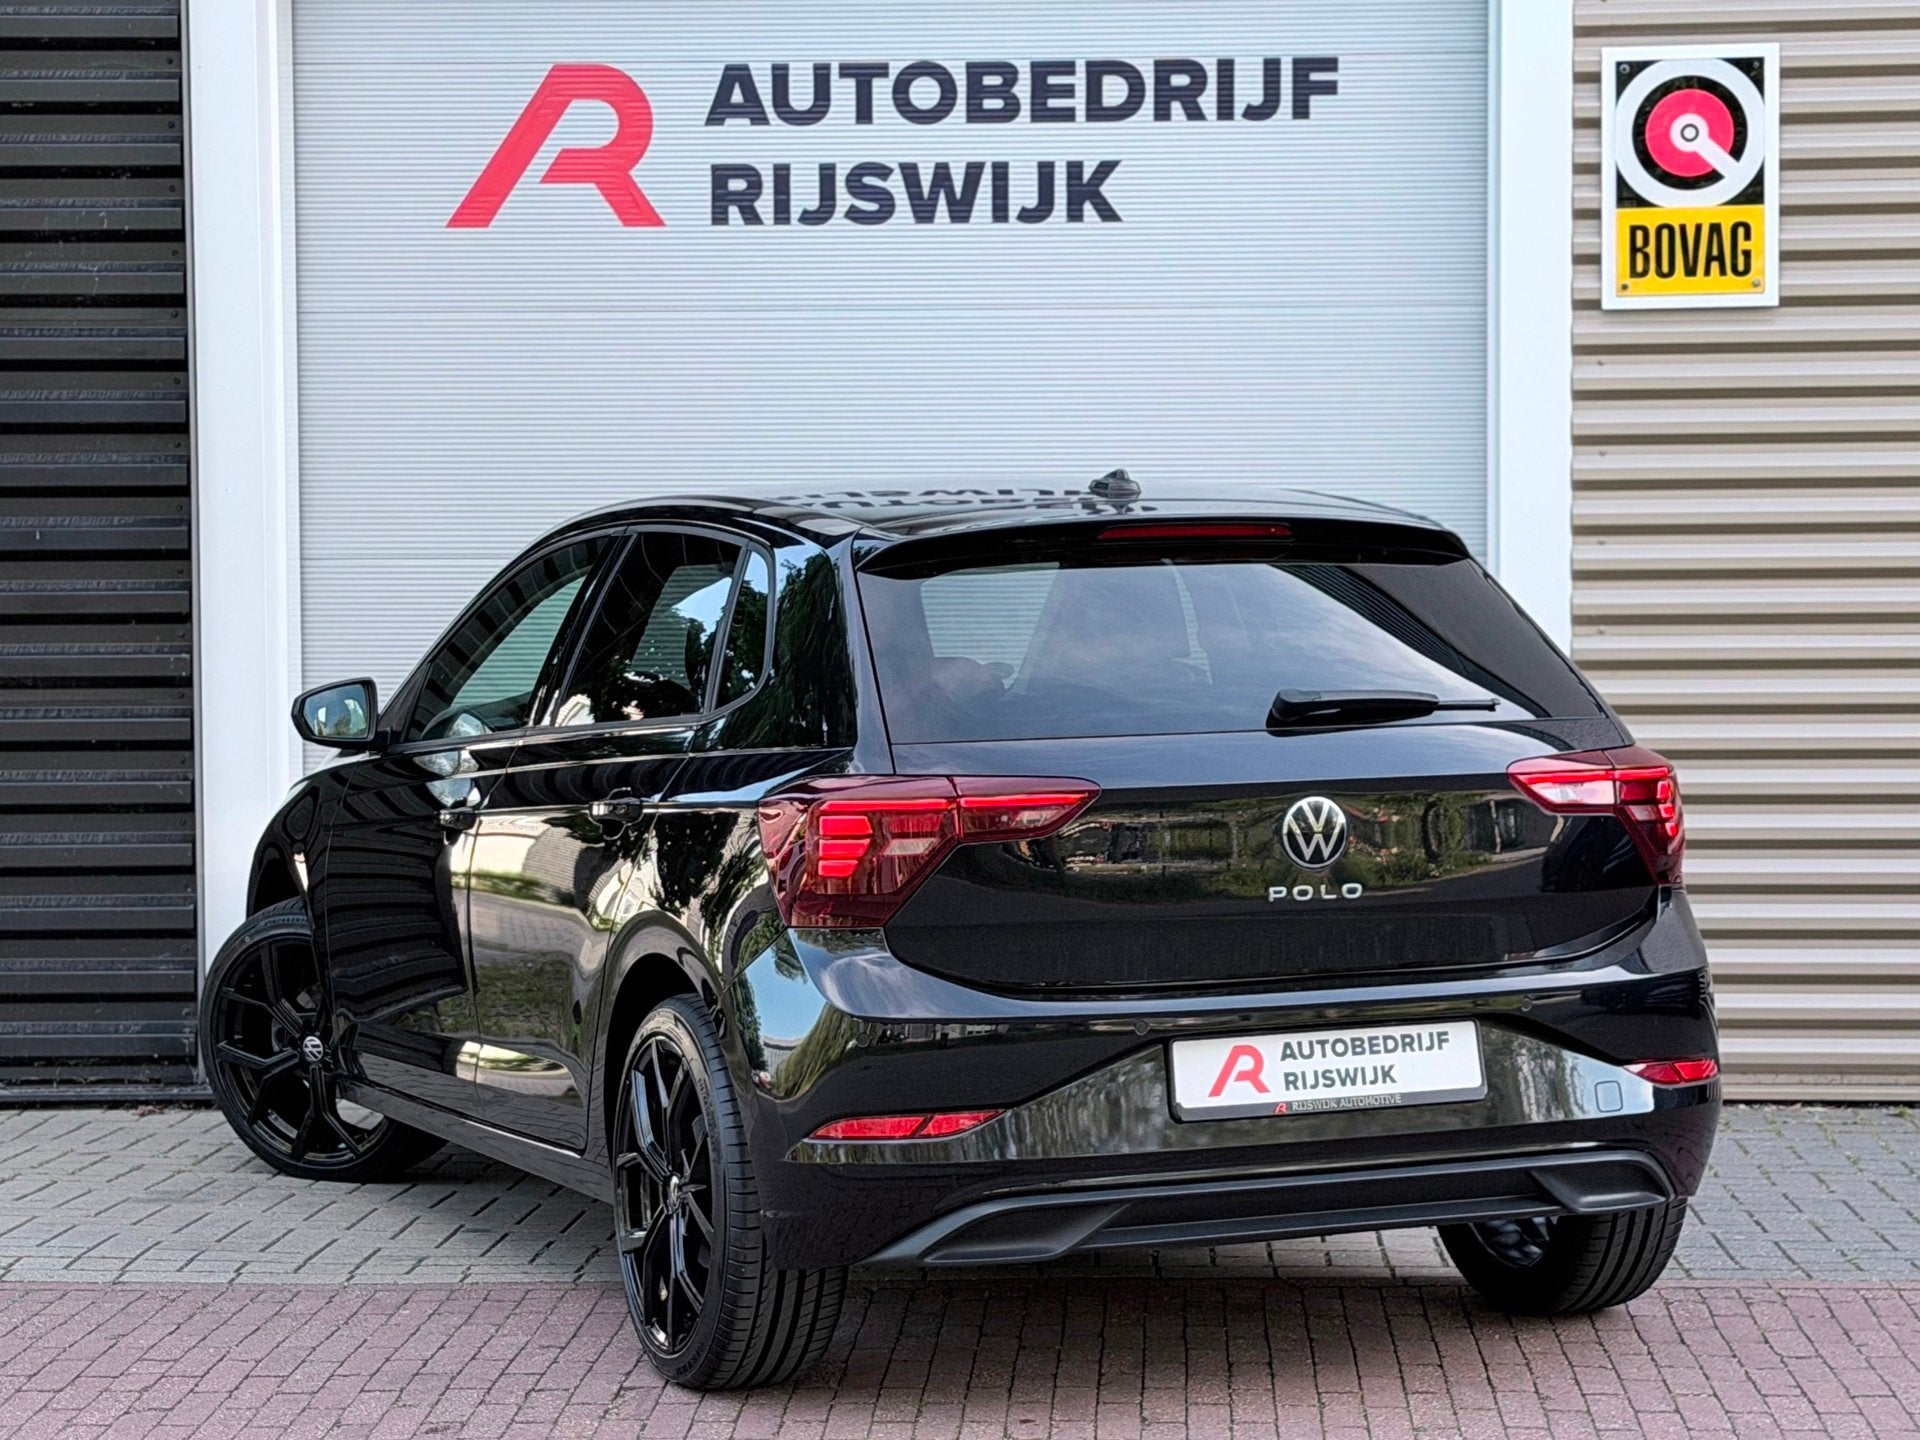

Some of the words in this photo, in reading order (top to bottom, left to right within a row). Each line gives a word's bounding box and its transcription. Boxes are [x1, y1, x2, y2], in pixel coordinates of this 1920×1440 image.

[704, 56, 1340, 126] AUTOBEDRIJF
[710, 160, 1122, 226] RIJSWIJK
[1628, 221, 1753, 279] BOVAG
[1268, 882, 1363, 902] POLO
[1279, 1030, 1451, 1062] AUTOBEDRIJF
[1283, 1064, 1397, 1091] RIJSWIJK
[1292, 1097, 1338, 1111] RIJSWIJK
[1339, 1093, 1402, 1107] AUTOMOTIVE
